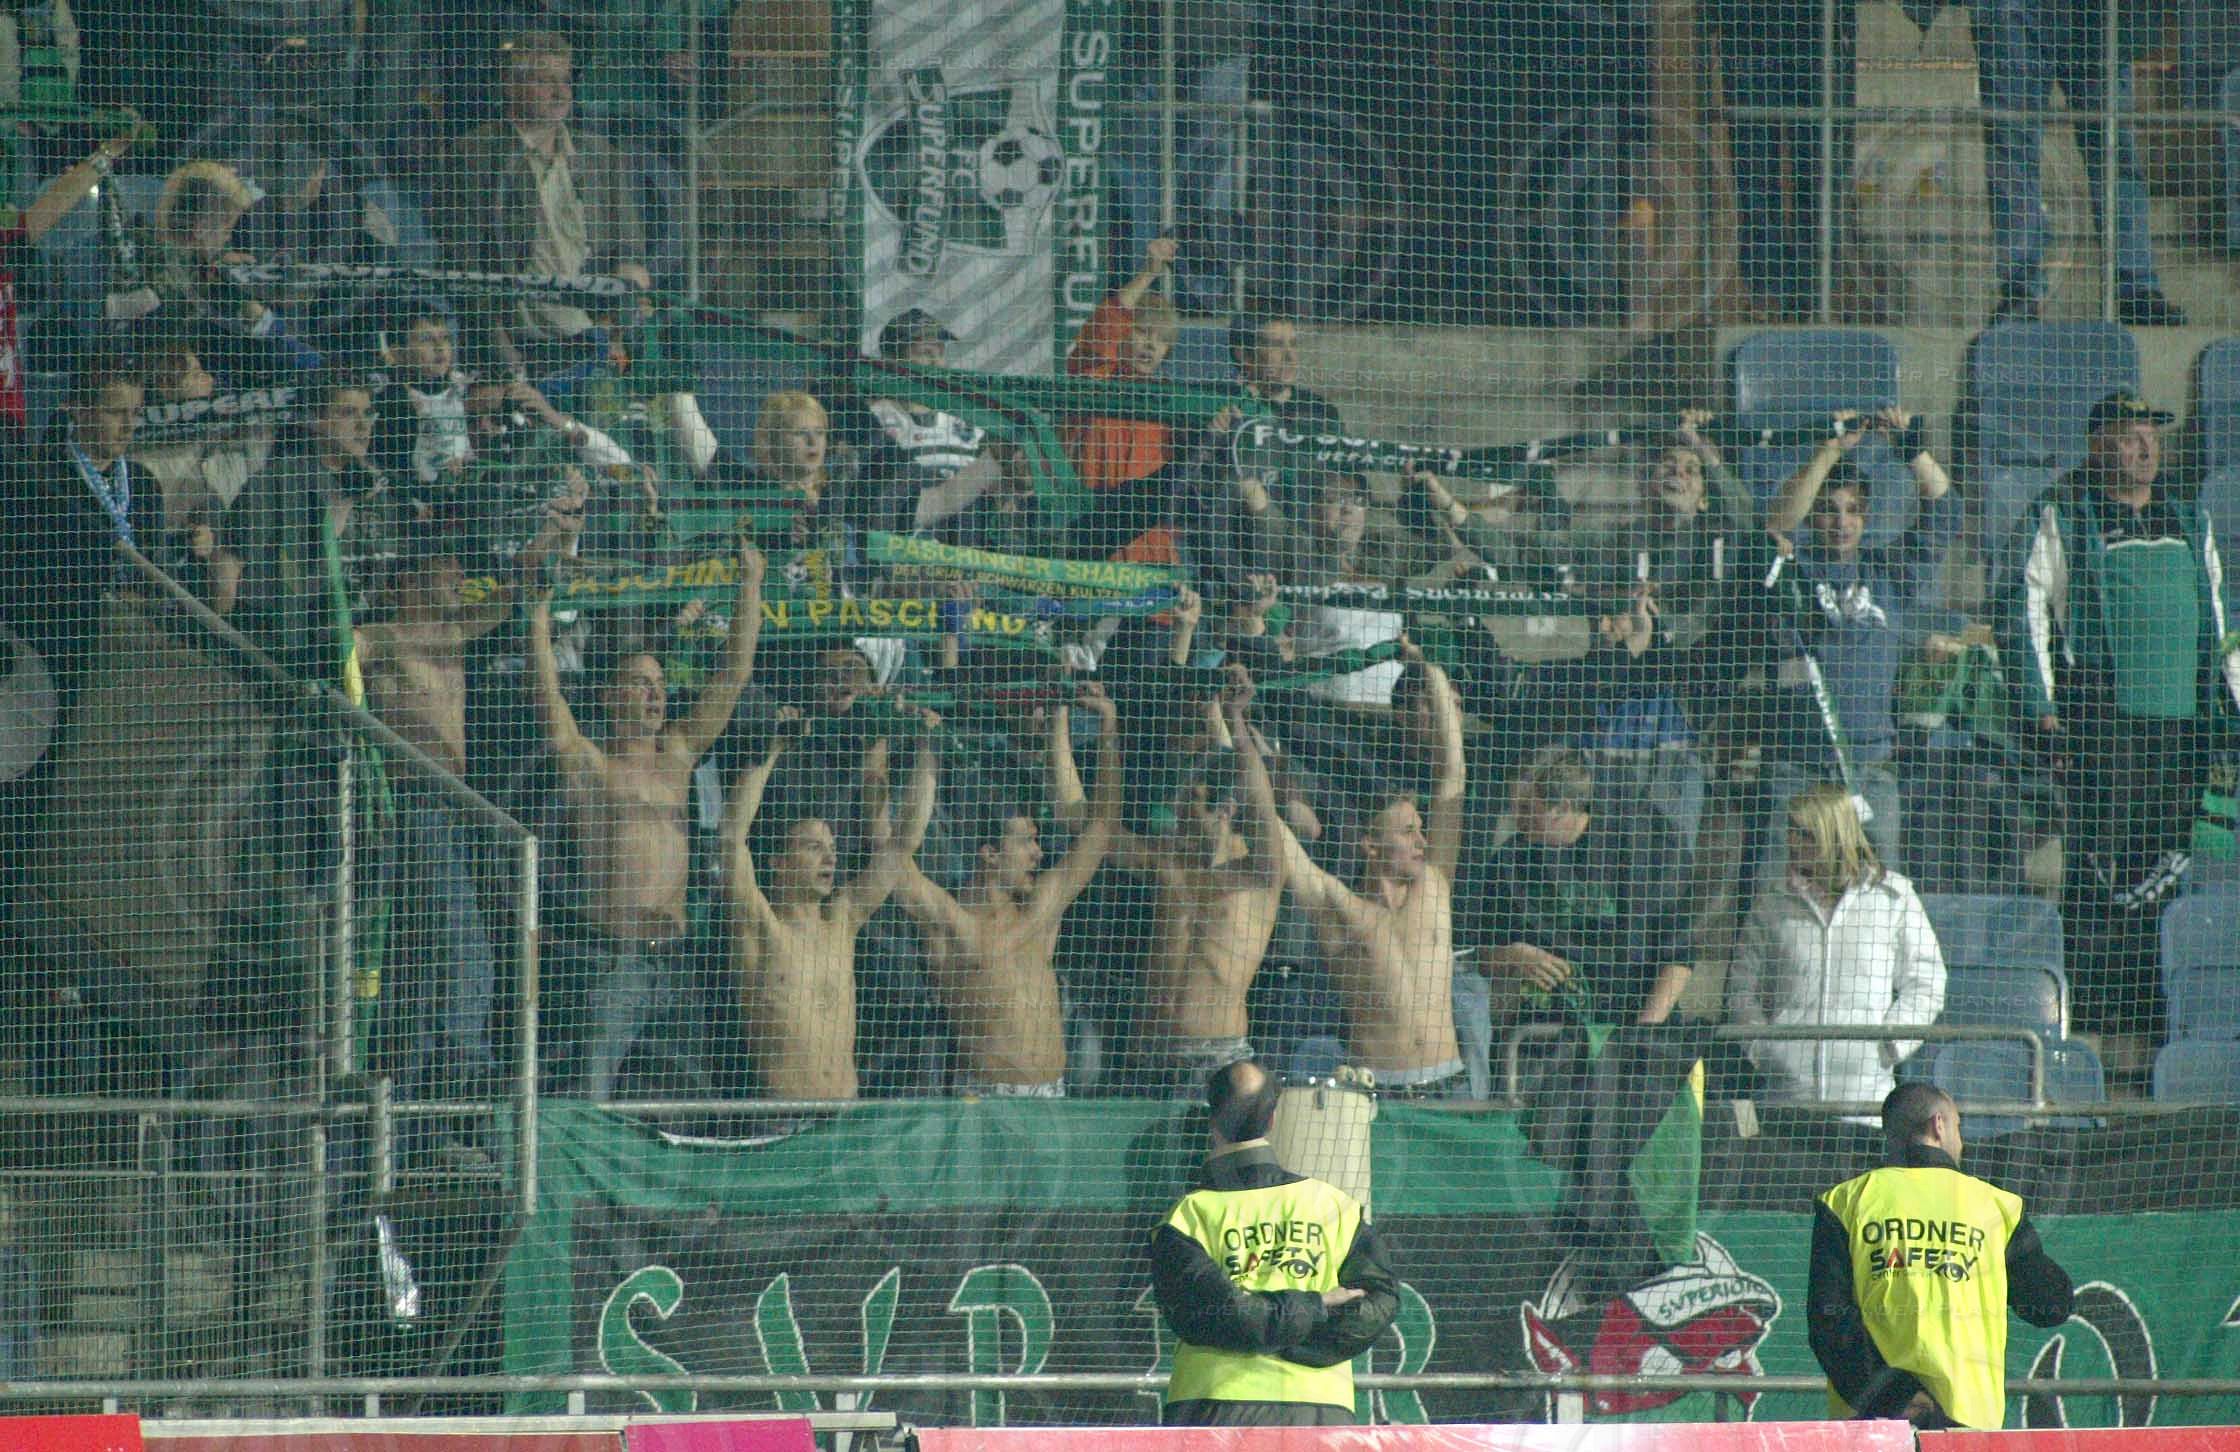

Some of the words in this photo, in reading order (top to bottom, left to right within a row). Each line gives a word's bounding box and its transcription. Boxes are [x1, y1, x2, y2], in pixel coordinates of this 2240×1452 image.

[1223, 1219, 1323, 1251] ORDNER
[1862, 1216, 1986, 1253] ORDNER
[1225, 1246, 1326, 1275] SAFETY
[1869, 1246, 1979, 1272] SAFETY
